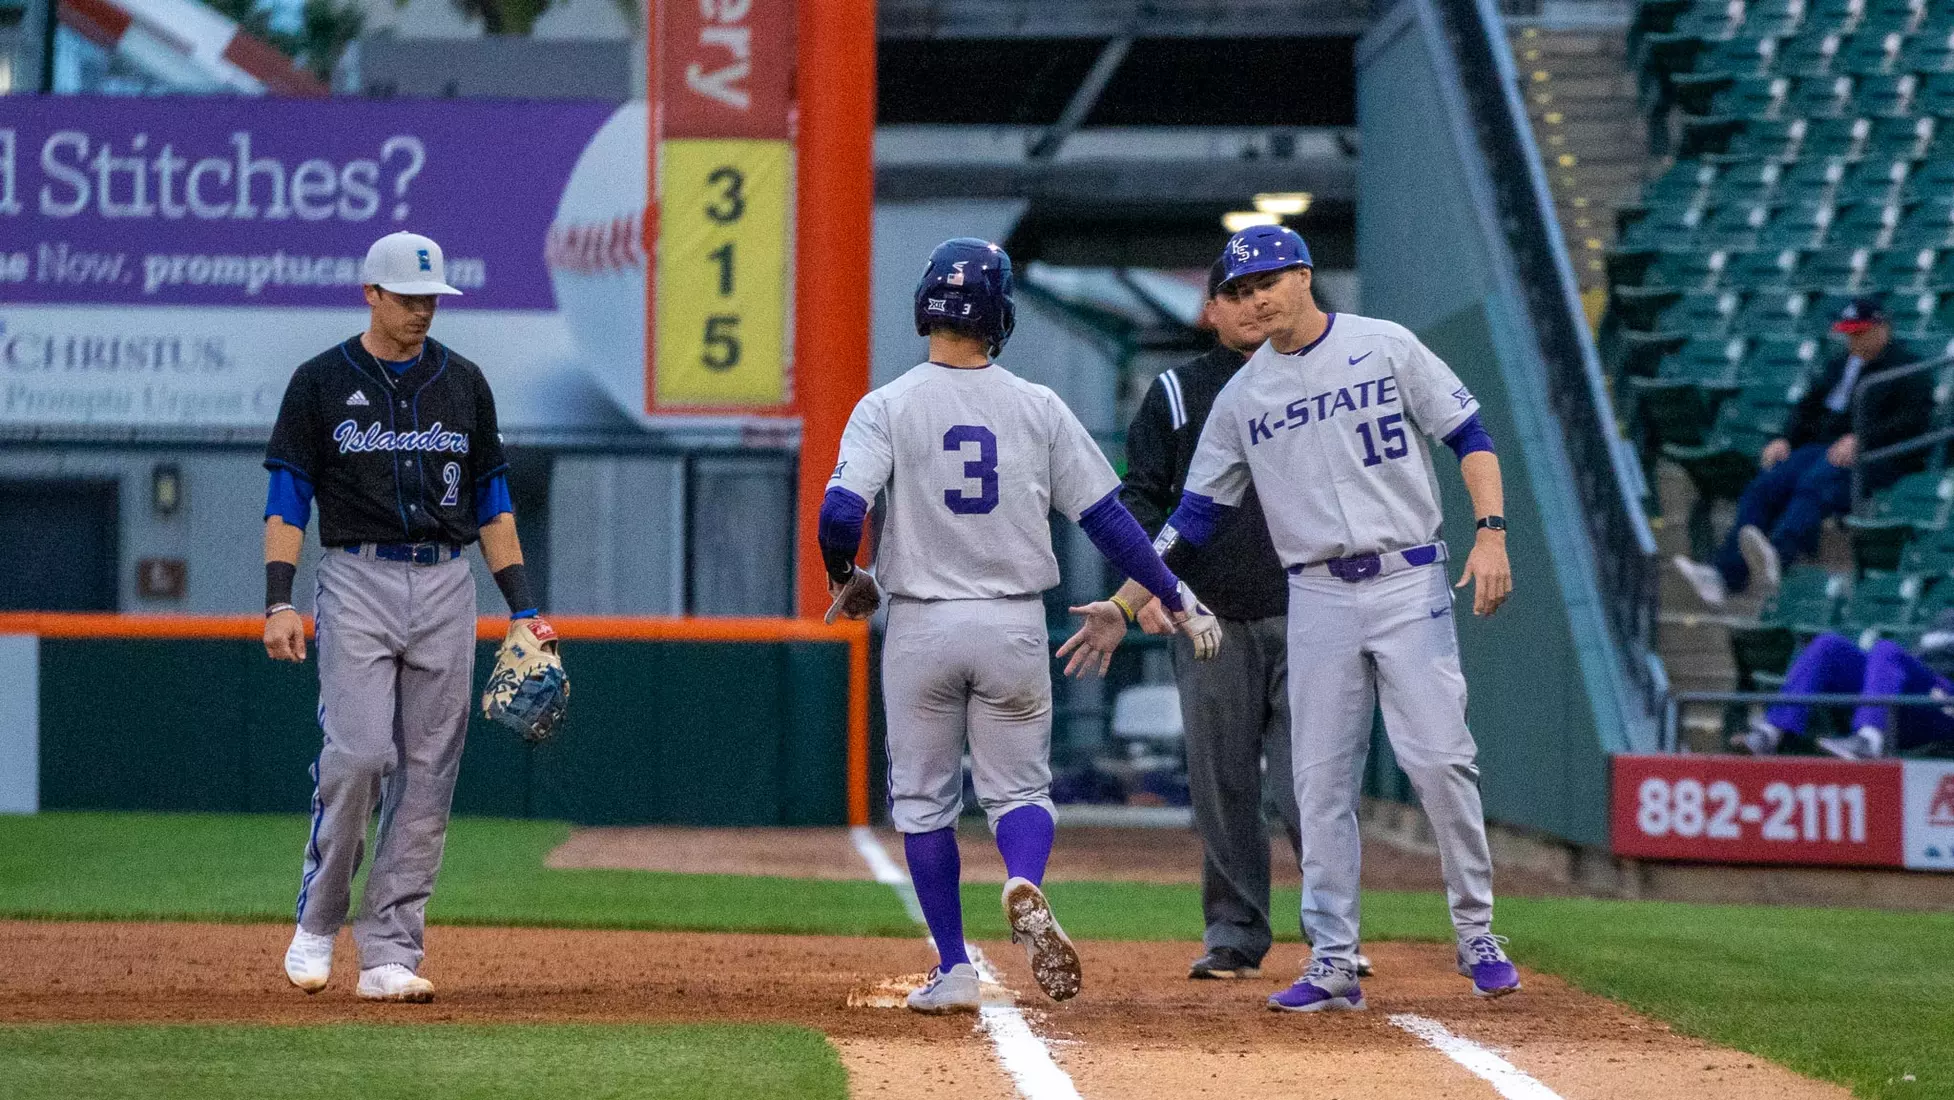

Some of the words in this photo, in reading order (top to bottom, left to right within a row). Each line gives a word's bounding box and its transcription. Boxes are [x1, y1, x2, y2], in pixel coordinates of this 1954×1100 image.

[39, 130, 426, 221] Stitches?
[962, 303, 971, 315] 3
[333, 419, 469, 453] Islanders
[1248, 375, 1398, 446] K-STATE
[1356, 412, 1409, 468] 15
[440, 462, 461, 505] 2
[943, 425, 999, 514] 3
[1637, 778, 1867, 844] 882-2111
